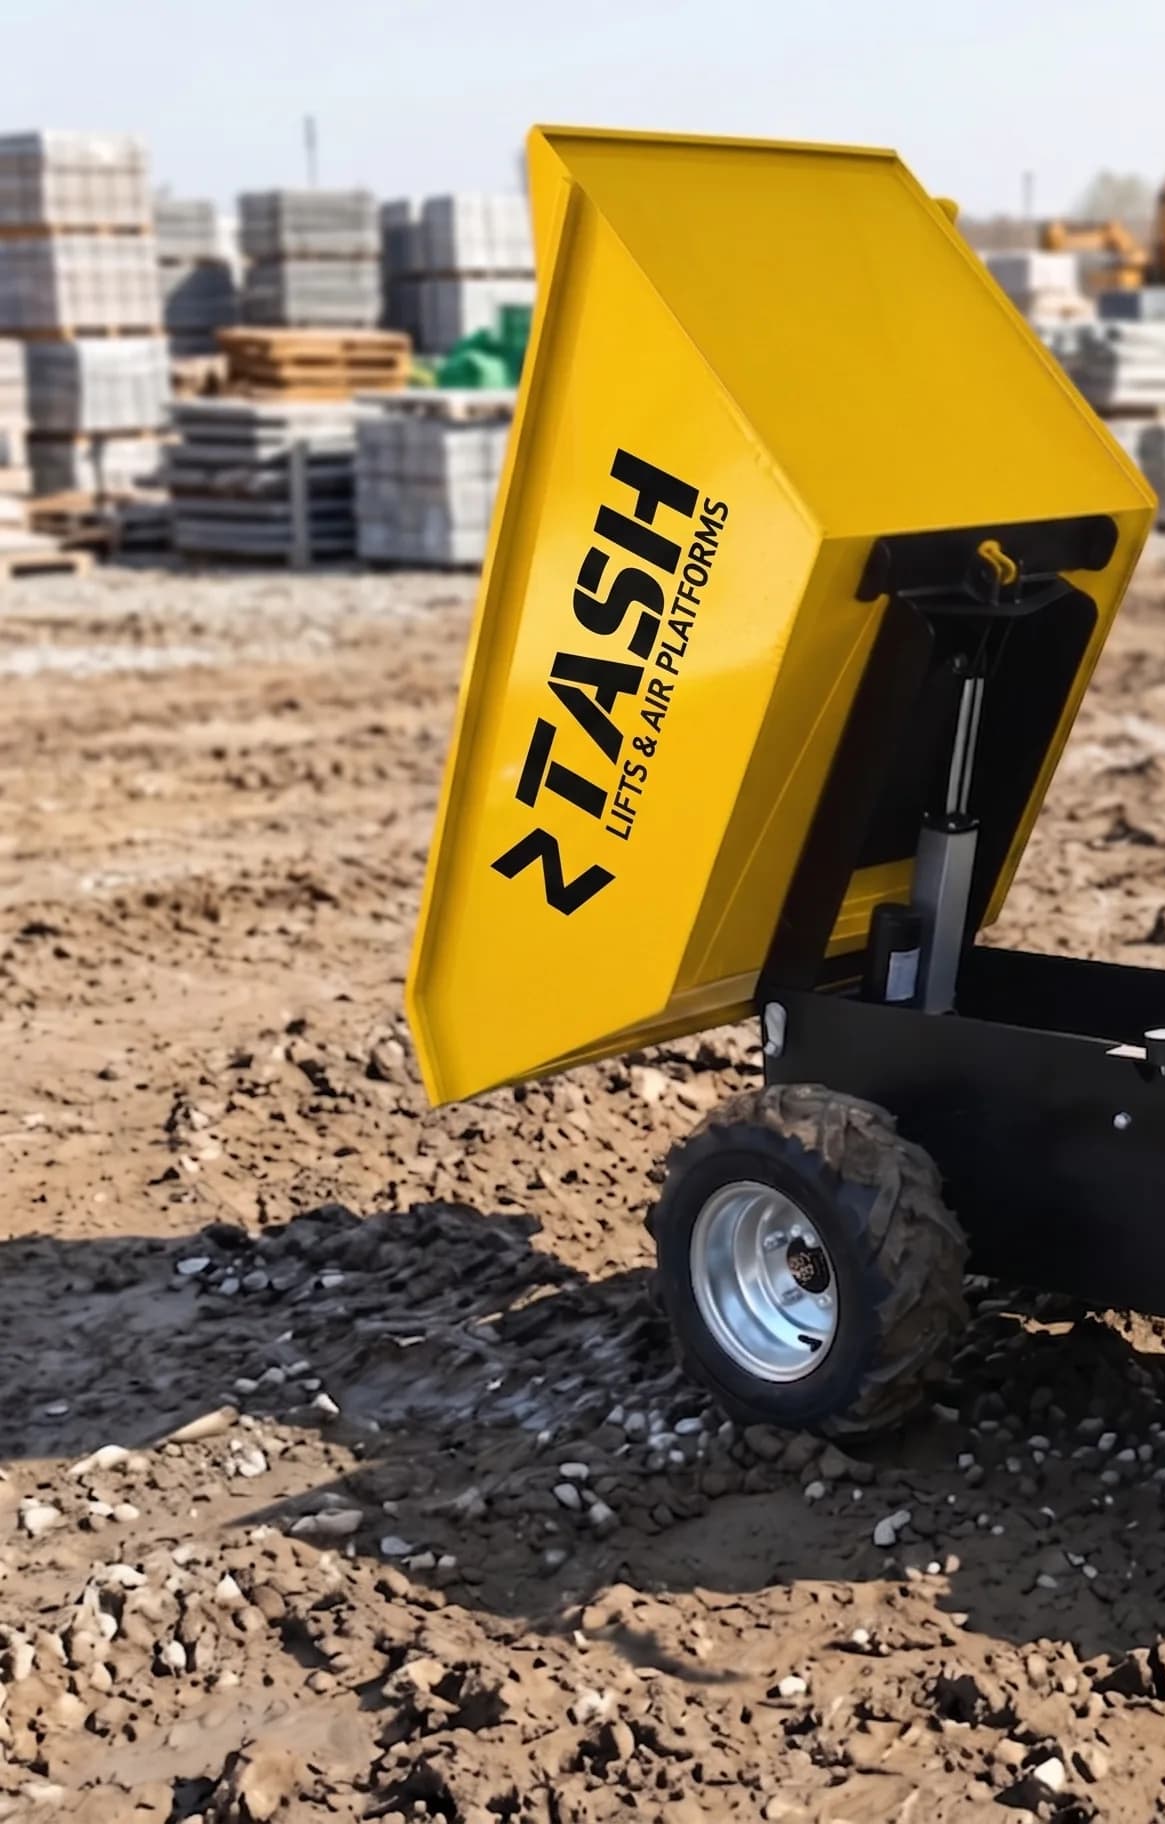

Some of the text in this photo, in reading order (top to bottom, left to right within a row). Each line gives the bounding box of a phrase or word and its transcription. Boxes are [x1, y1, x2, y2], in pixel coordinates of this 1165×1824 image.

[514, 447, 699, 820] TASH
[605, 497, 729, 841] LIFTS & AIR PLATFORMS
